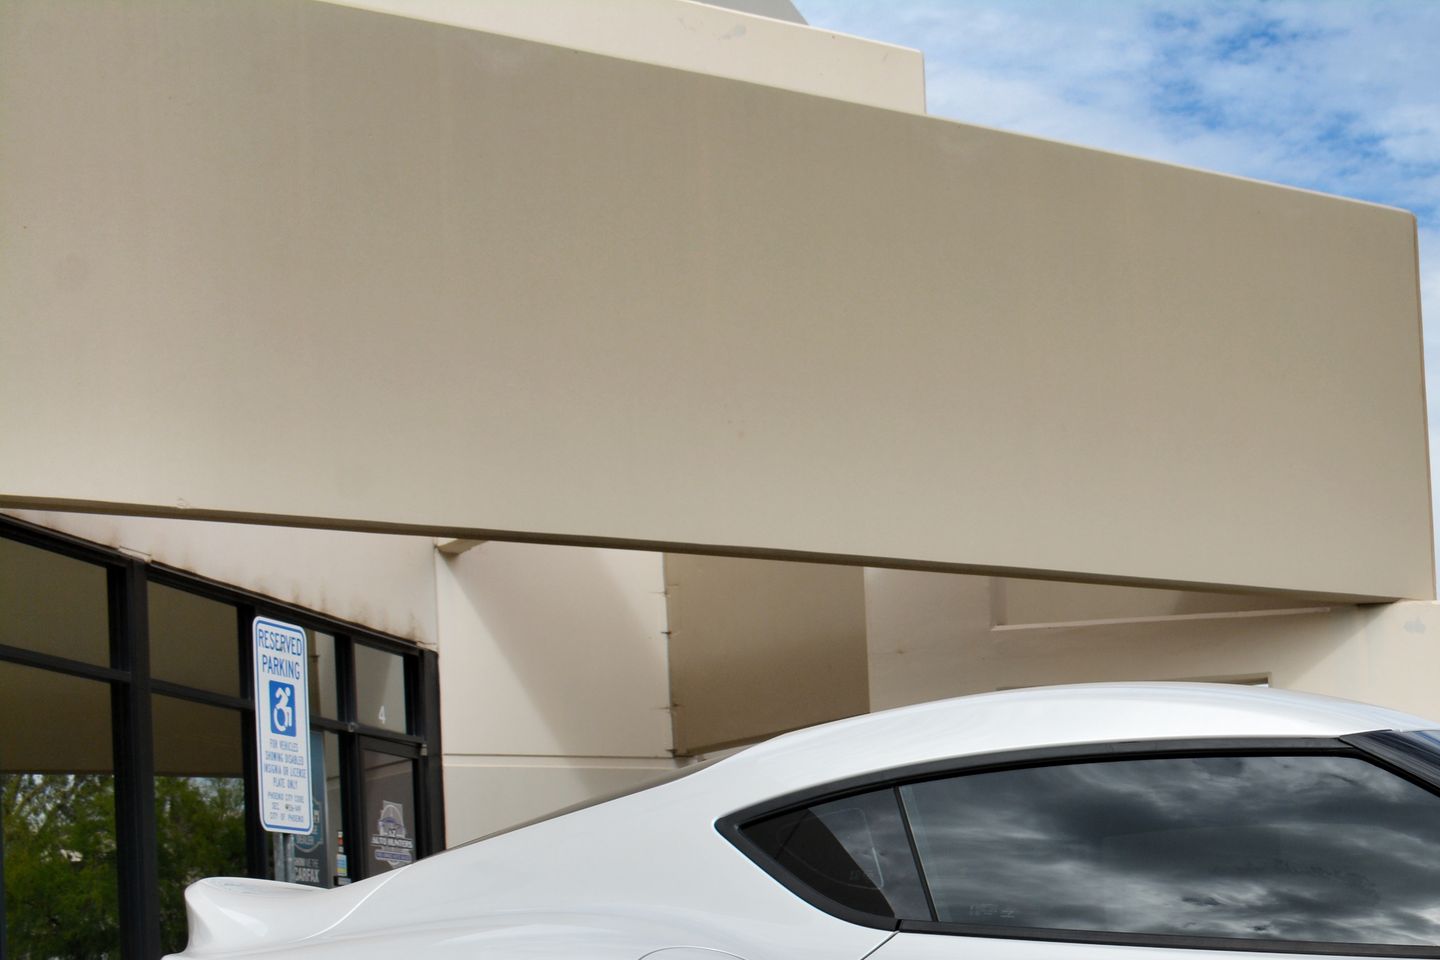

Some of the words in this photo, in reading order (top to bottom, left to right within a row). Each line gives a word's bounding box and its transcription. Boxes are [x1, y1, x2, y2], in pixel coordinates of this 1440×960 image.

[258, 628, 302, 656] RESERVED
[262, 654, 300, 680] PARKING
[378, 705, 386, 724] 4
[269, 738, 278, 749] FOR
[279, 740, 299, 752] VEHICLES
[265, 751, 284, 763] SHOWING
[285, 753, 304, 766] DISABLED
[273, 777, 286, 788] PLATE
[287, 779, 298, 790] ONLY
[371, 836, 387, 846] AUTO
[294, 867, 320, 883] CARFAX
